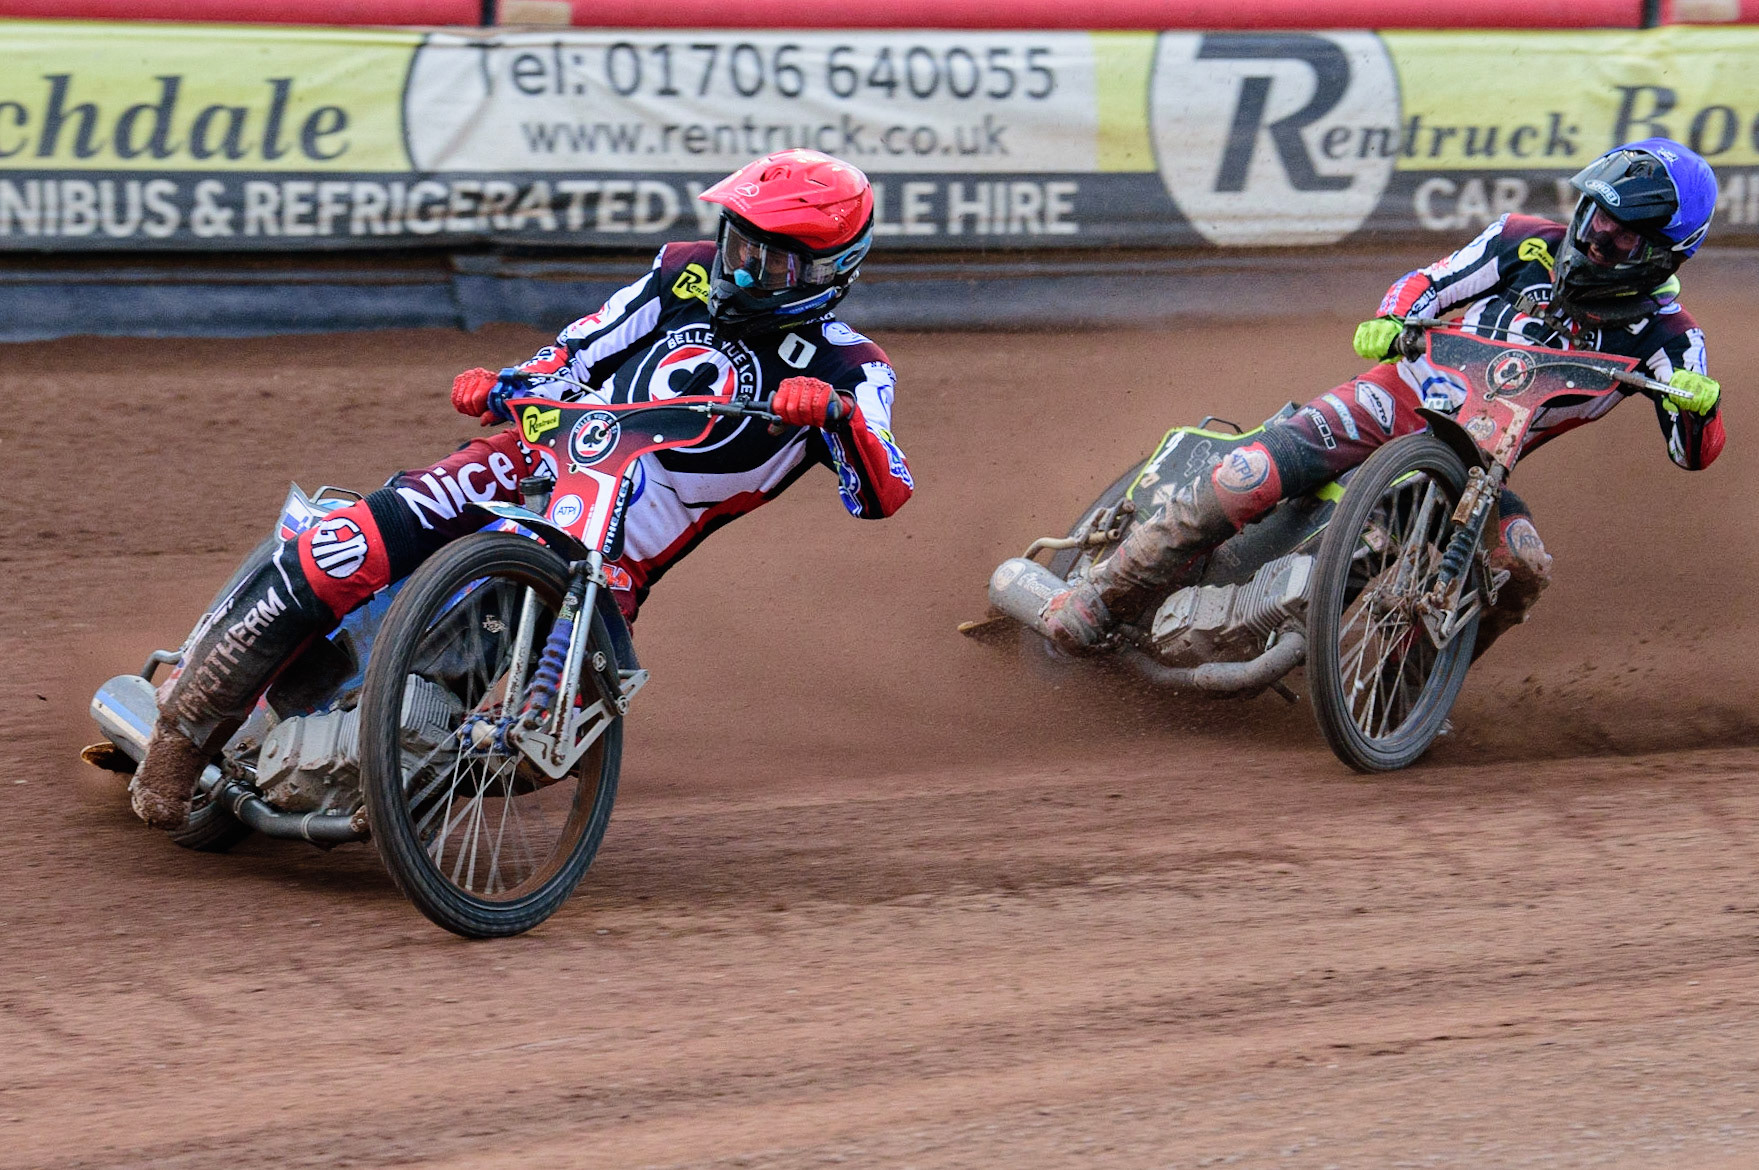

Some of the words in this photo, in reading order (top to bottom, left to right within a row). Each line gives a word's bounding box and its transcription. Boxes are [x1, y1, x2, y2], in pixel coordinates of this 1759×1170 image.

[606, 43, 803, 97] 01706
[827, 44, 1056, 99] 640055
[0, 74, 351, 161] chdale
[521, 115, 1010, 156] www.rentruck.co.uk
[1195, 33, 1581, 193] Rentruck
[1611, 85, 1759, 157] Bo
[0, 179, 180, 238] NIBUS
[192, 180, 235, 238] &
[245, 180, 680, 237] REFRIGERATED
[948, 181, 1081, 235] HIRE
[1412, 177, 1531, 232] CAR
[1588, 181, 1617, 204] SHOEI
[667, 331, 715, 350] BELLE
[720, 340, 747, 366] VUE
[788, 340, 805, 364] 1
[396, 452, 517, 530] Nice
[1231, 454, 1253, 482] ATPI
[557, 506, 577, 516] ATPI
